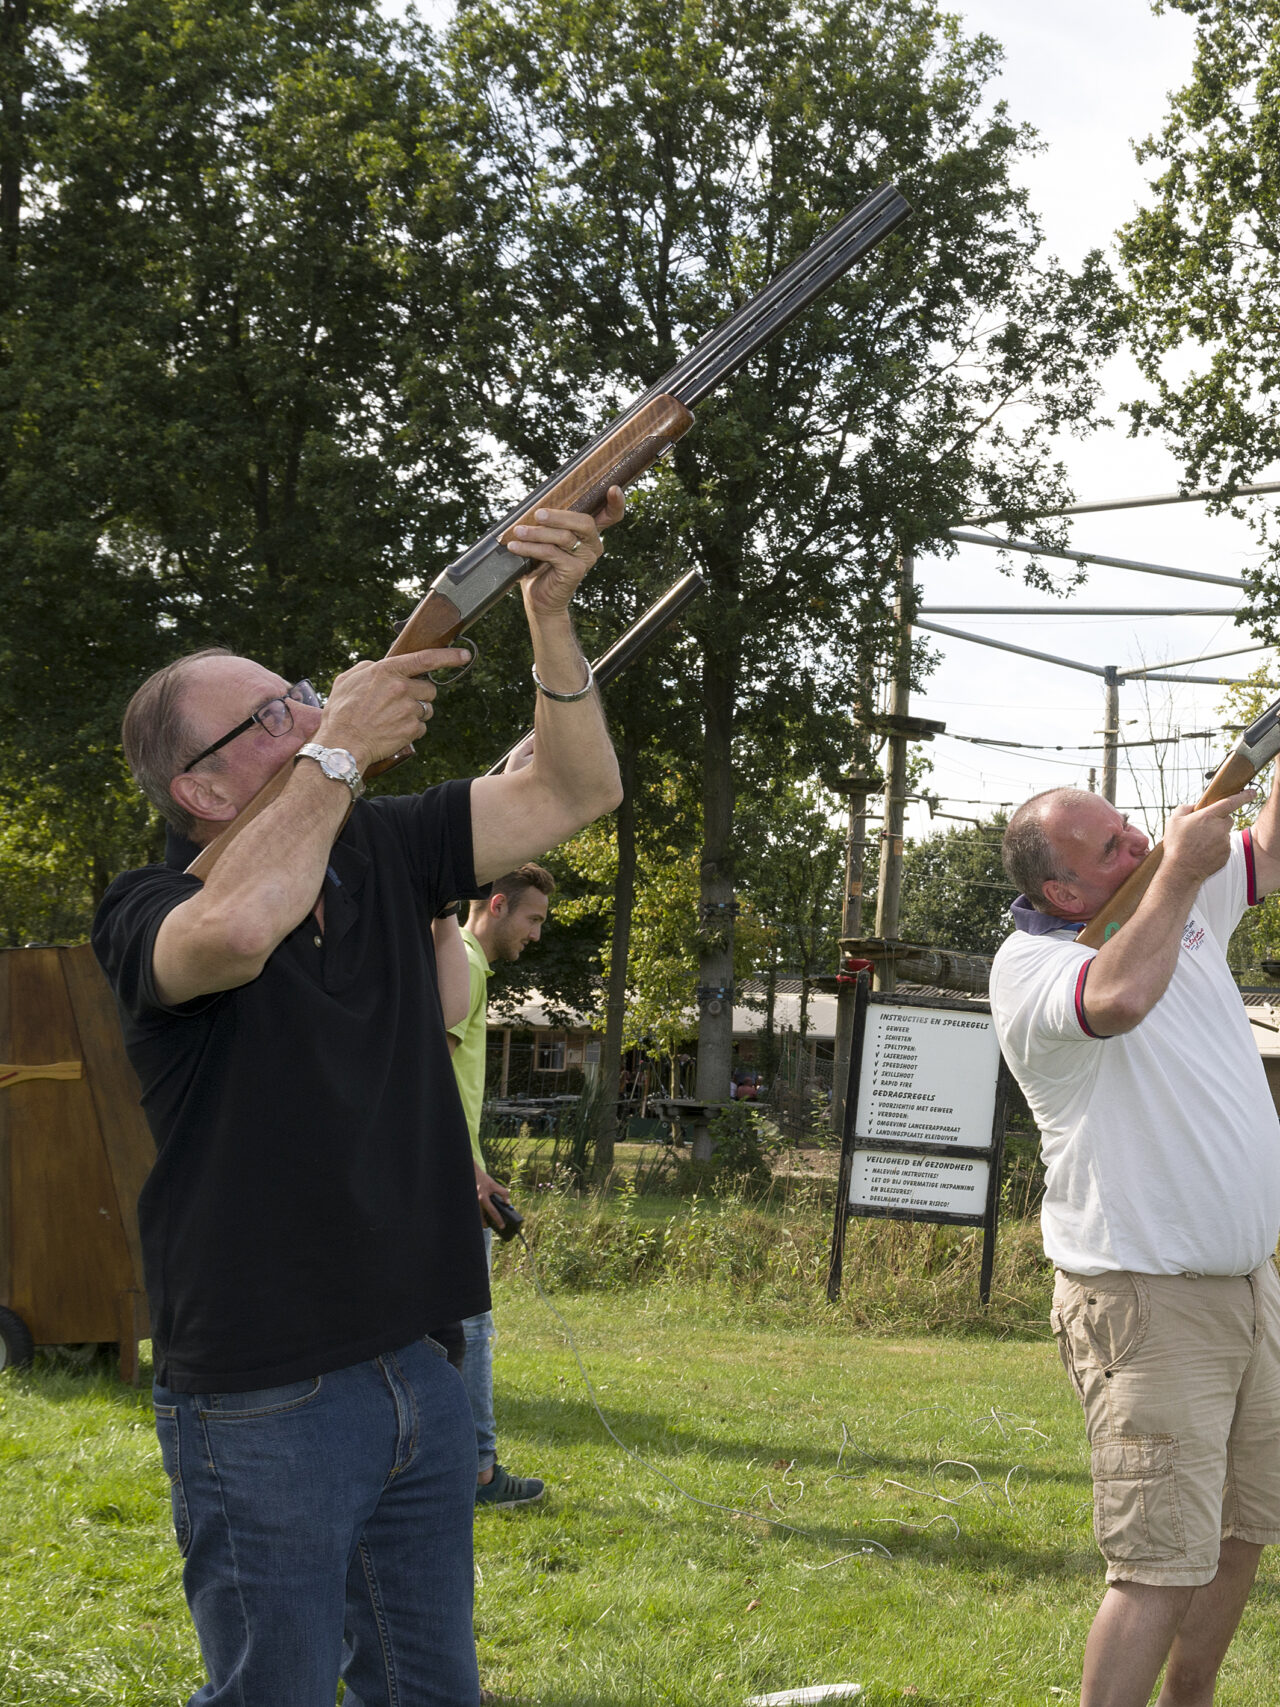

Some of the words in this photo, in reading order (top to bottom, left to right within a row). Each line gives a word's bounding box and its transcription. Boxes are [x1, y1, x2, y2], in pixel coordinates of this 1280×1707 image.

[880, 1014, 928, 1024] INSTRUCTIES
[943, 1020, 989, 1030] SPELREGELS
[884, 1053, 918, 1061] LASERSHOOT
[882, 1062, 918, 1070] SPEEDSHOOT
[872, 1090, 936, 1101] GEDRAGSREGELS
[878, 1102, 914, 1110] VOORZICHTIG
[877, 1120, 907, 1128] OMGEVING
[908, 1123, 961, 1132] LANCEERAPPARAAT
[876, 1129, 923, 1138] LANDINGSPLAATS
[924, 1133, 958, 1141] KLEIDUIVEN
[867, 1156, 909, 1166] VEILIGHEID
[925, 1161, 973, 1171] GEZONDHEID
[872, 1168, 900, 1176] NALEVING
[901, 1171, 939, 1179] INSTRUCTIES!
[880, 1187, 912, 1195] BLESSURES!
[903, 1180, 938, 1188] OVERMATIGE
[940, 1183, 975, 1191] INSPANNING
[870, 1195, 899, 1203] DEELNAME
